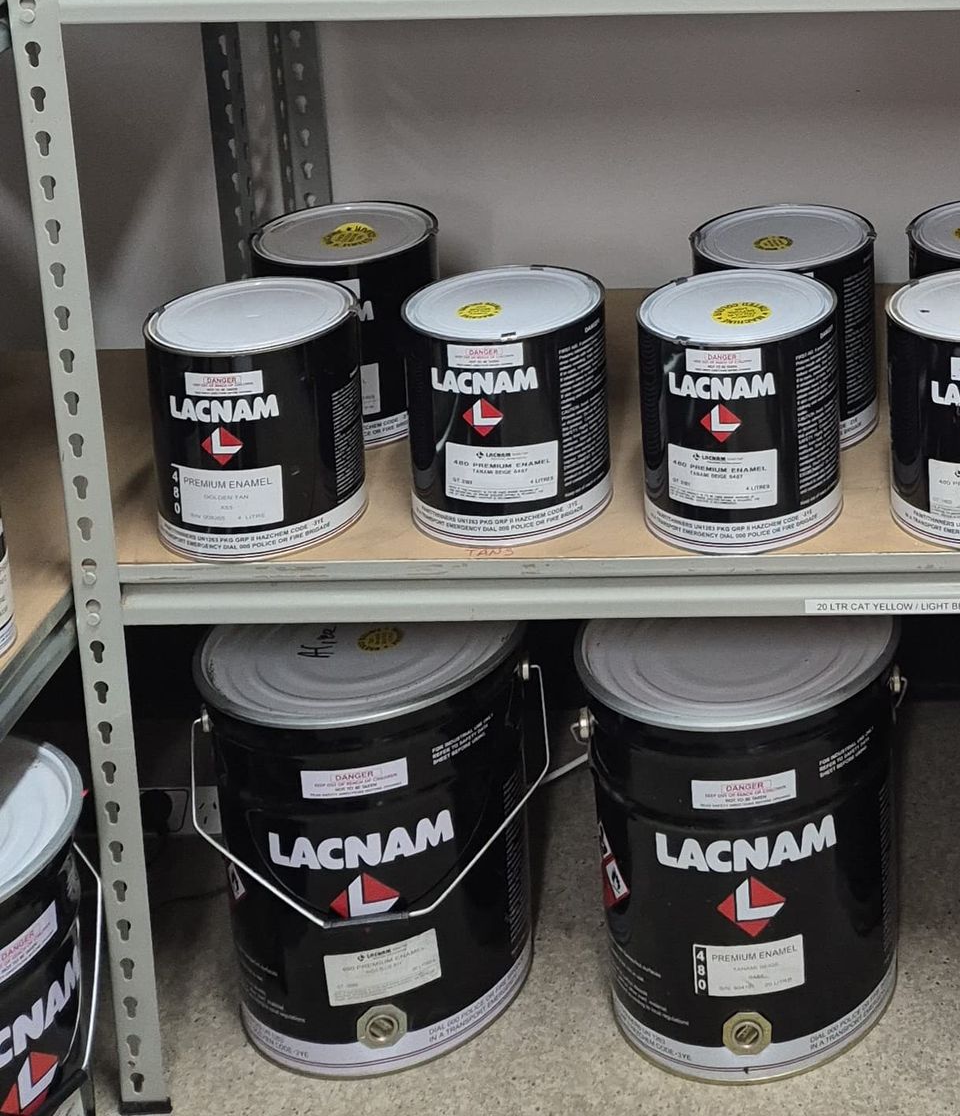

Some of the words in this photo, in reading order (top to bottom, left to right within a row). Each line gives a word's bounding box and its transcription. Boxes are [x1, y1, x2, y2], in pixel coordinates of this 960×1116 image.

[431, 367, 538, 395] LACNAM
[669, 371, 775, 400] LACNAM
[169, 394, 279, 423] LACNAM
[184, 477, 227, 489] PREMIUM
[229, 477, 272, 488] ENAMEL
[921, 602, 948, 610] LIGHT
[335, 771, 374, 781] DANGER
[726, 782, 764, 792] DANGER
[268, 809, 454, 870] LACNAM
[655, 815, 837, 872] LACNAM
[712, 952, 756, 963] PREMIUM
[759, 945, 798, 960] ENAMEL
